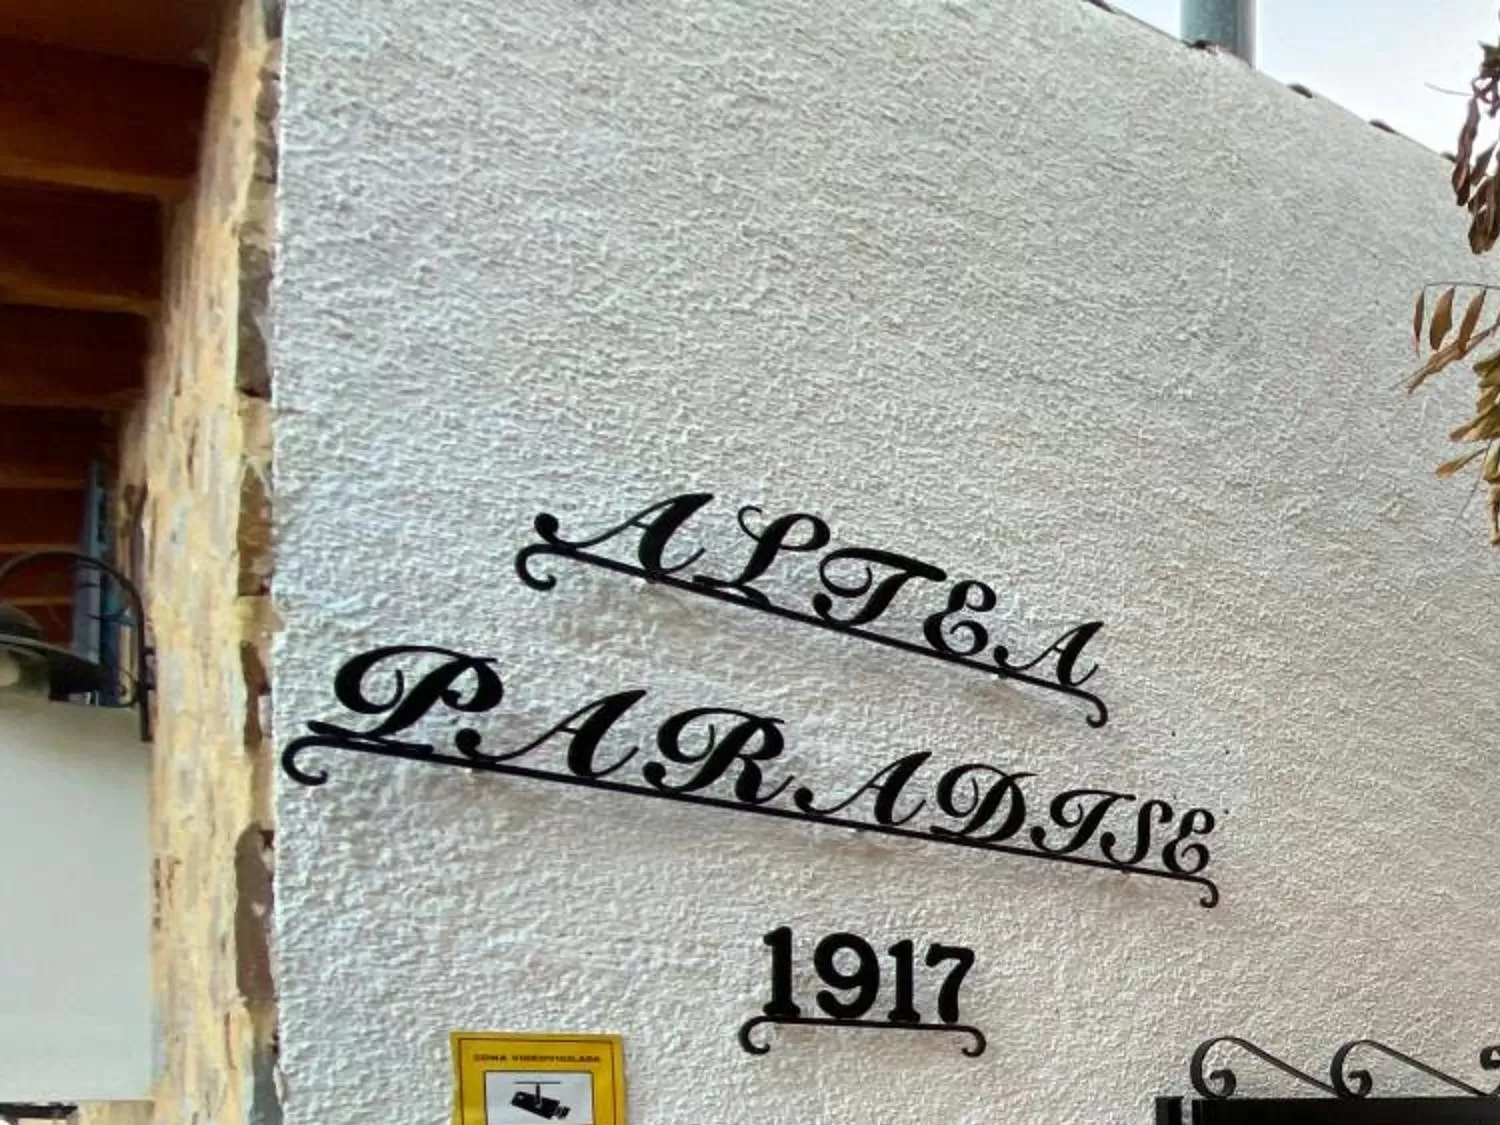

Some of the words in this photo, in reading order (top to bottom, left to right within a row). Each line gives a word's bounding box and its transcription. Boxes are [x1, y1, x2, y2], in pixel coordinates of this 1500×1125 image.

[533, 492, 1106, 689] ALTEA
[306, 645, 1216, 877] PARADISE
[763, 926, 976, 1025] 1917
